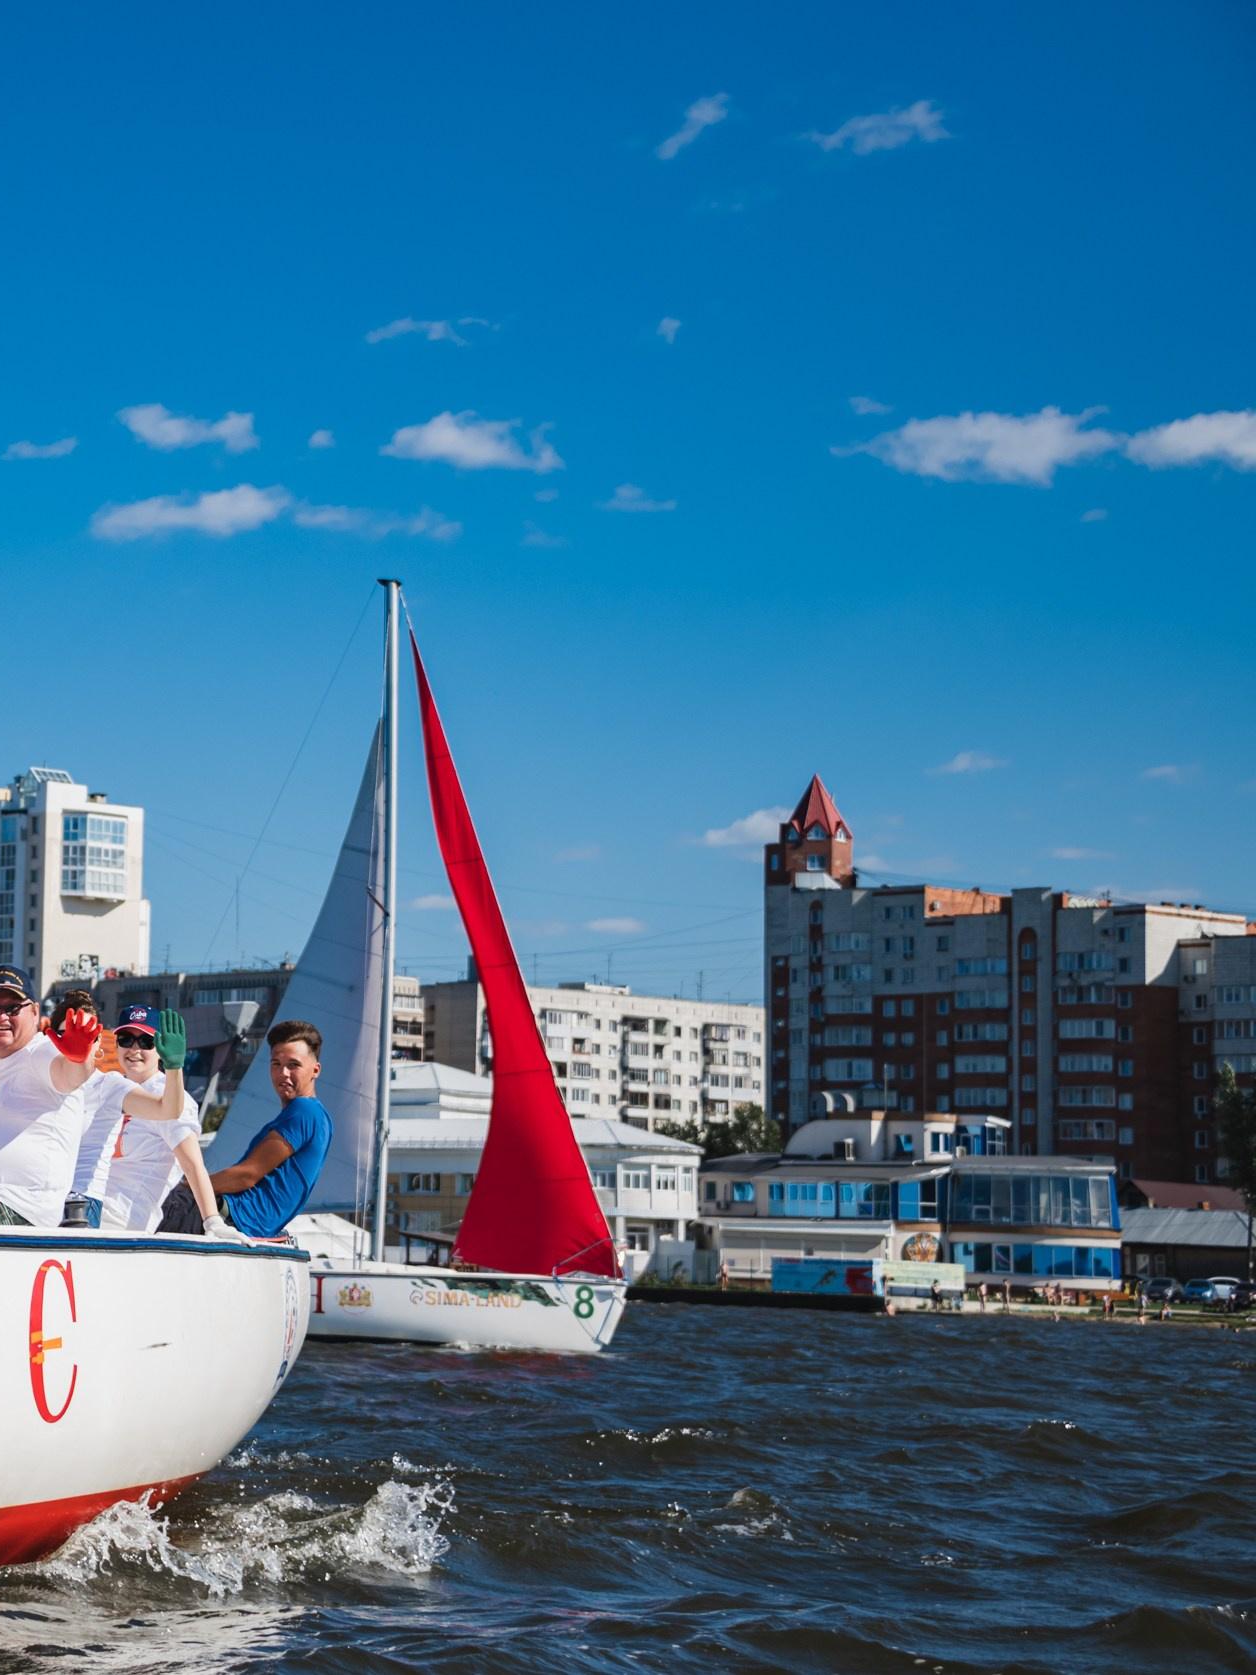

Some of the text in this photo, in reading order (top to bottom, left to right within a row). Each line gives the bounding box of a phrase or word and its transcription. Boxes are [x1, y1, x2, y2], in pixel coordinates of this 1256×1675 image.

[129, 1011, 147, 1020] Cuba
[425, 1290, 522, 1308] SIMA-LAND
[573, 1285, 595, 1319] 8
